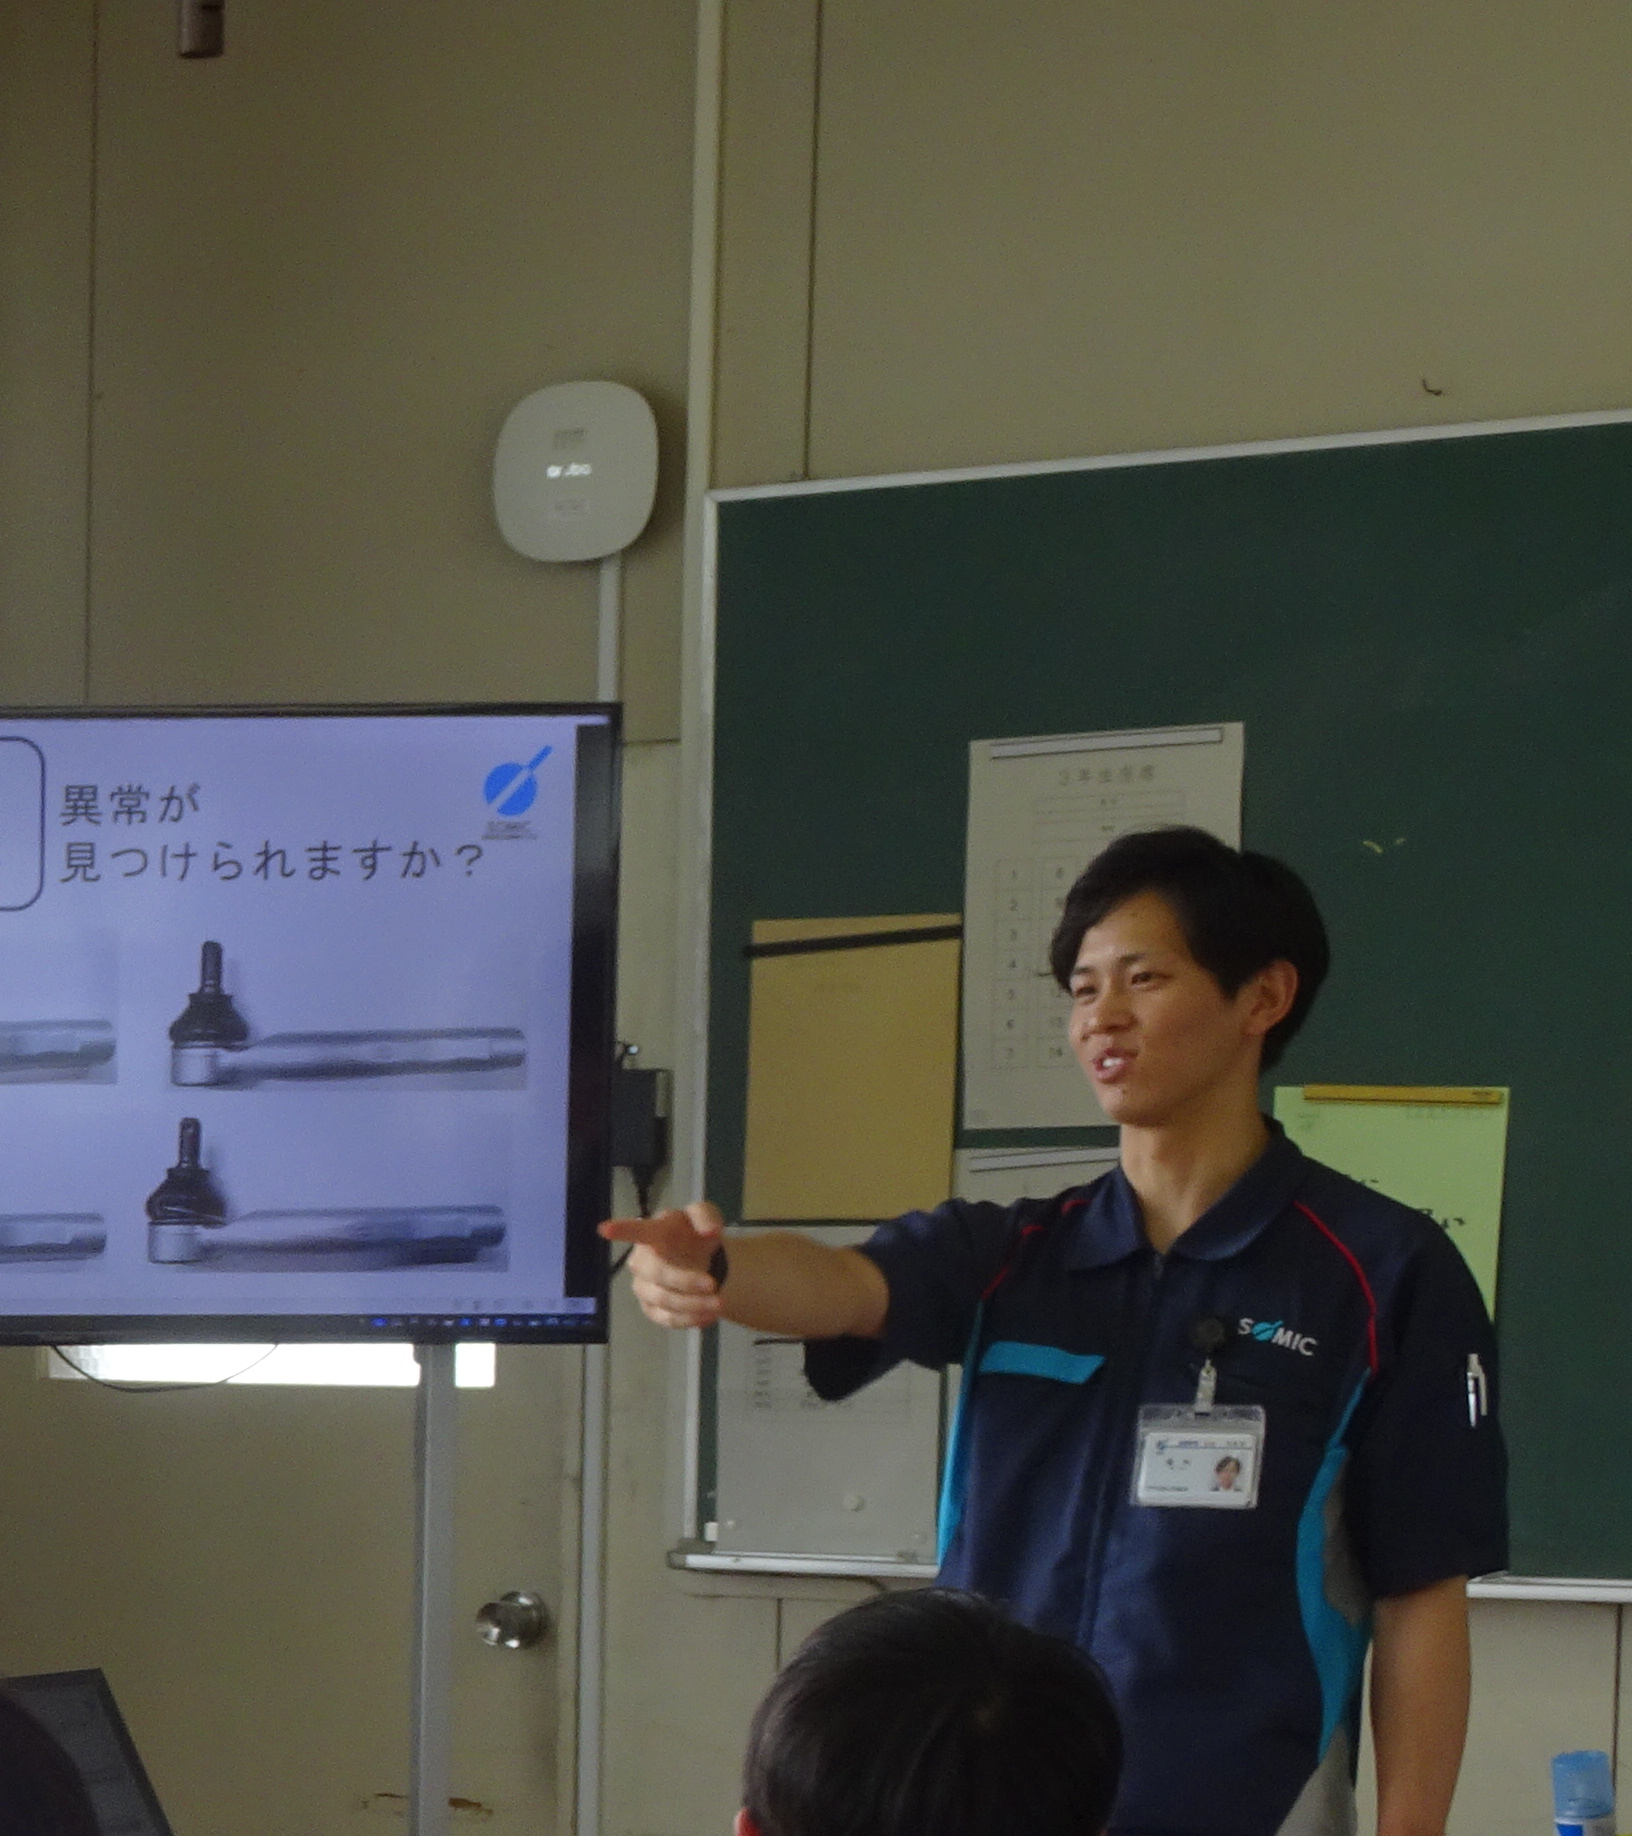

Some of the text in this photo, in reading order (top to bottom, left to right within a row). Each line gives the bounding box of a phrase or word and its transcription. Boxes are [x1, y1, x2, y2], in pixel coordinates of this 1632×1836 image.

[60, 783, 200, 826] 異常が
[59, 839, 484, 883] 見つけられますか？
